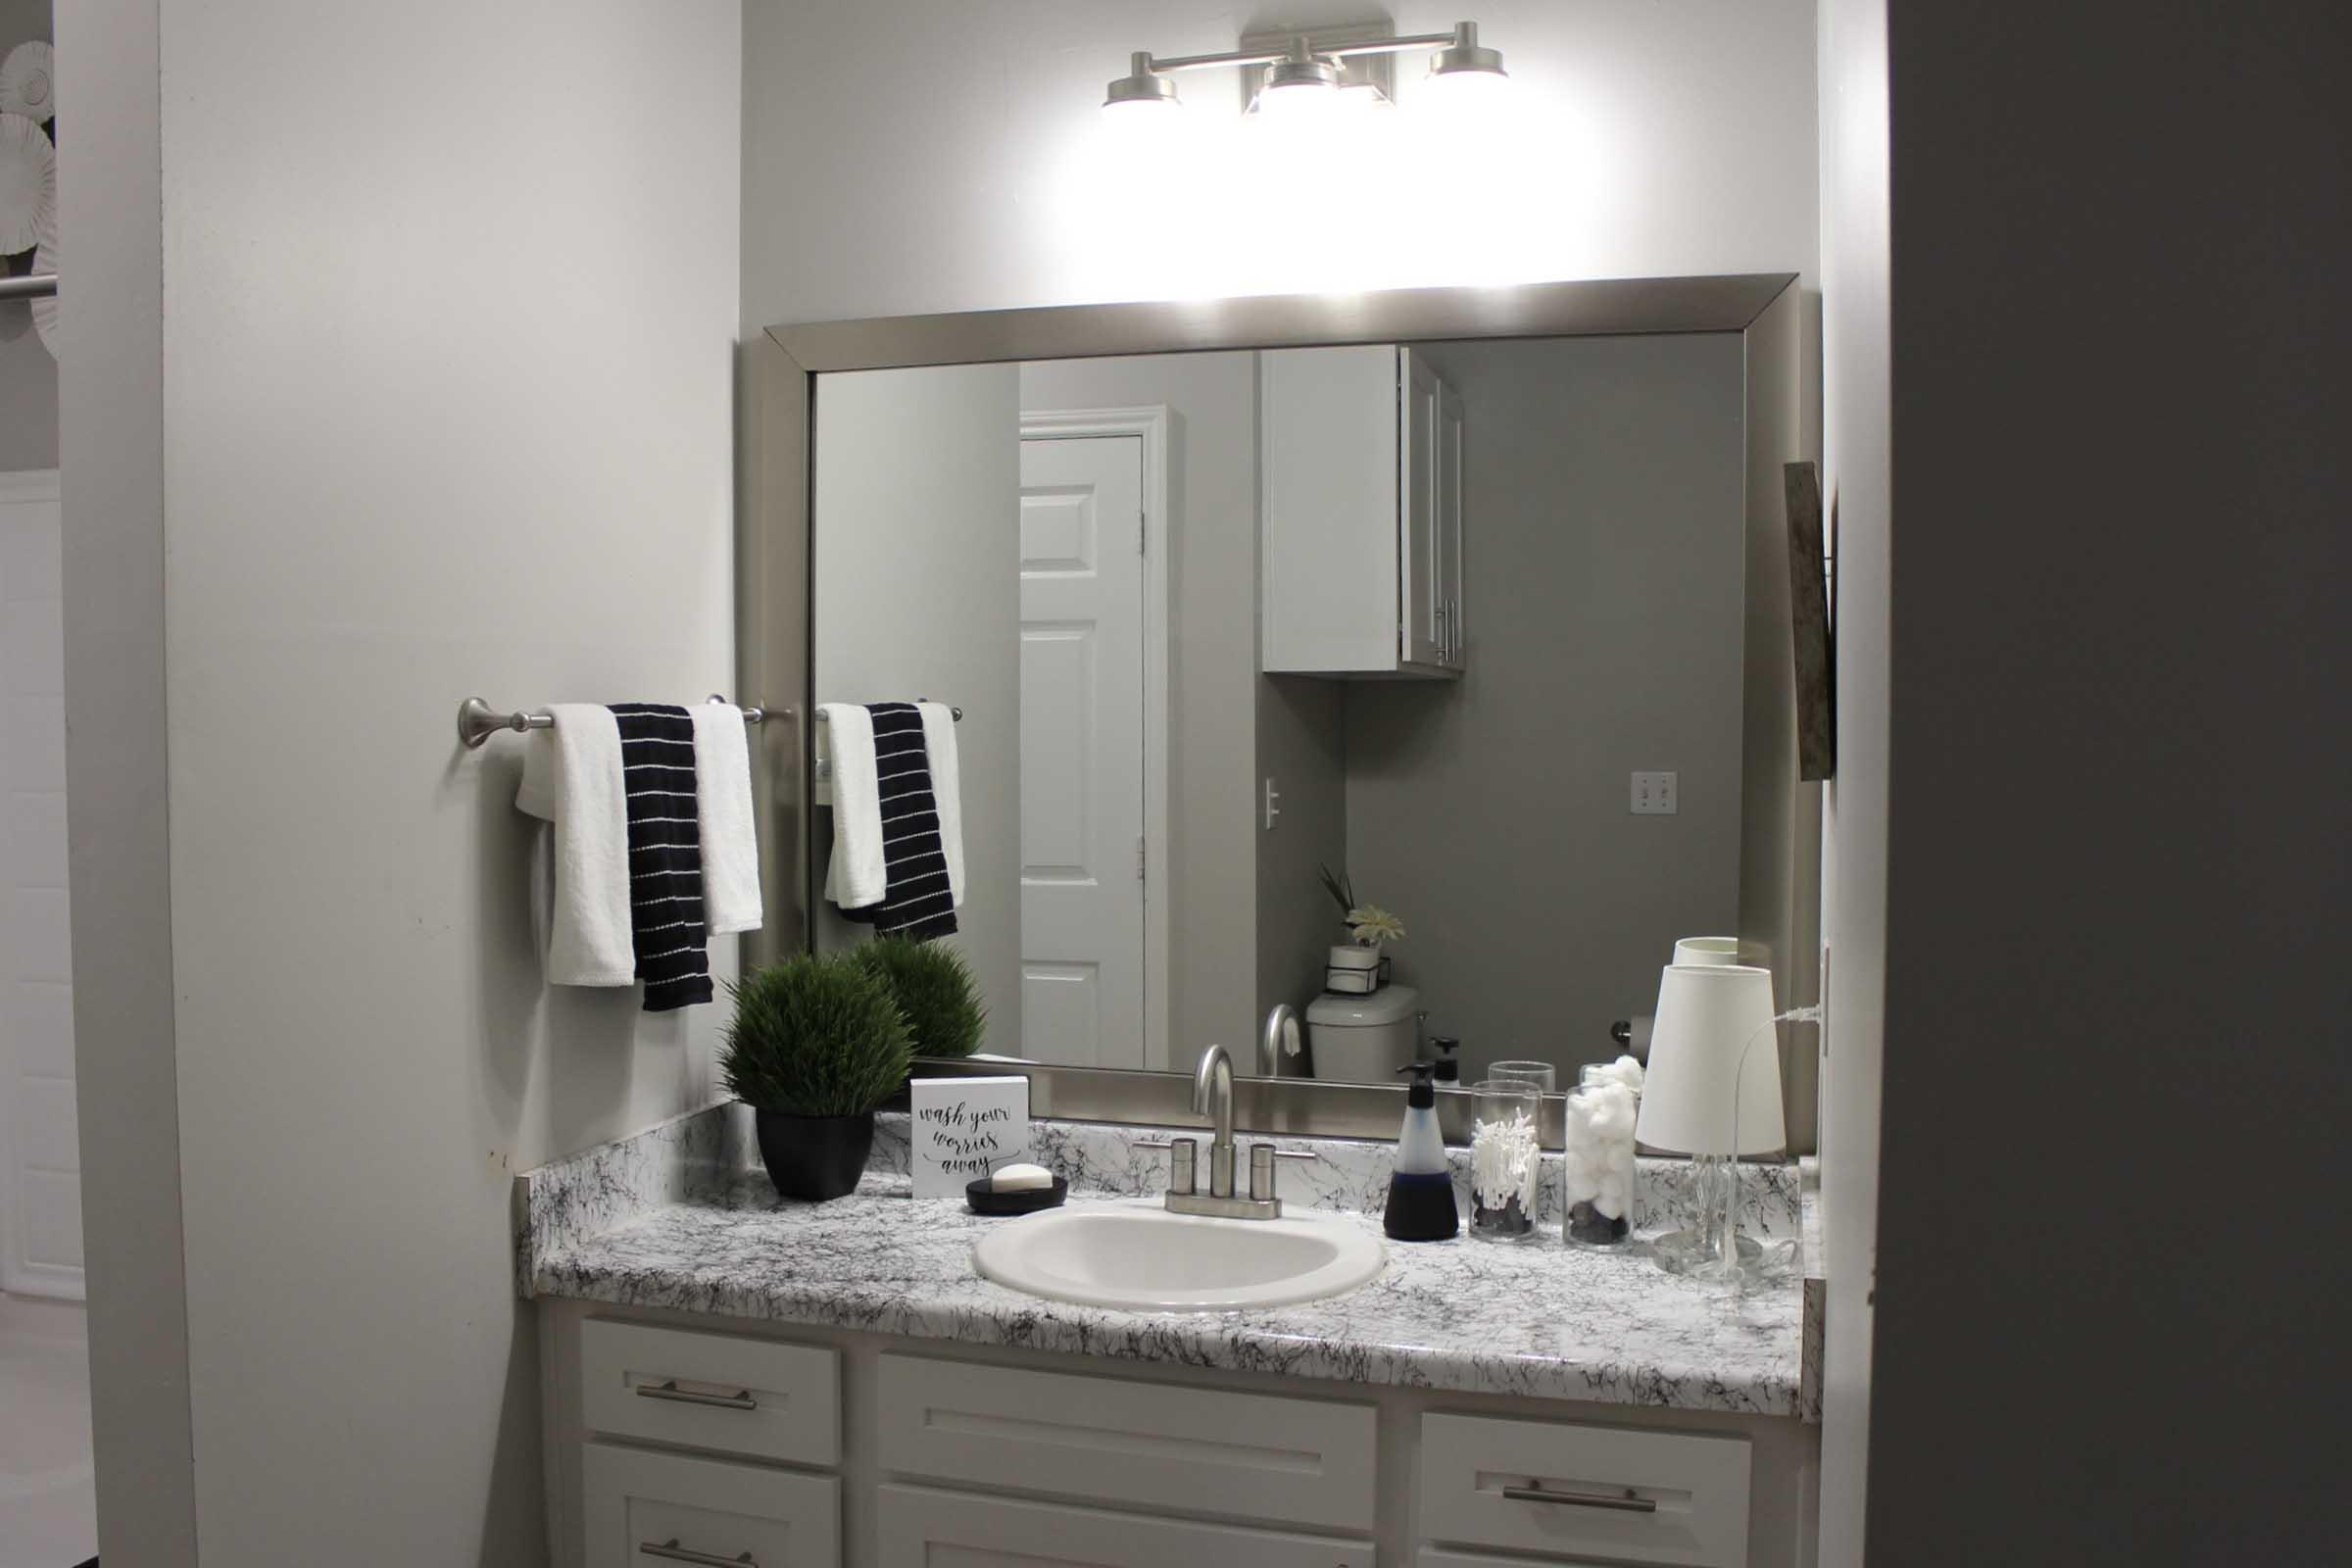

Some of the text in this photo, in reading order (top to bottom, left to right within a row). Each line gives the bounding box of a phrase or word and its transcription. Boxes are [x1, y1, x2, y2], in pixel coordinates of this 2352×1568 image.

[919, 1102, 1010, 1132] wash your
[933, 1131, 999, 1155] worries
[941, 1156, 990, 1177] away
